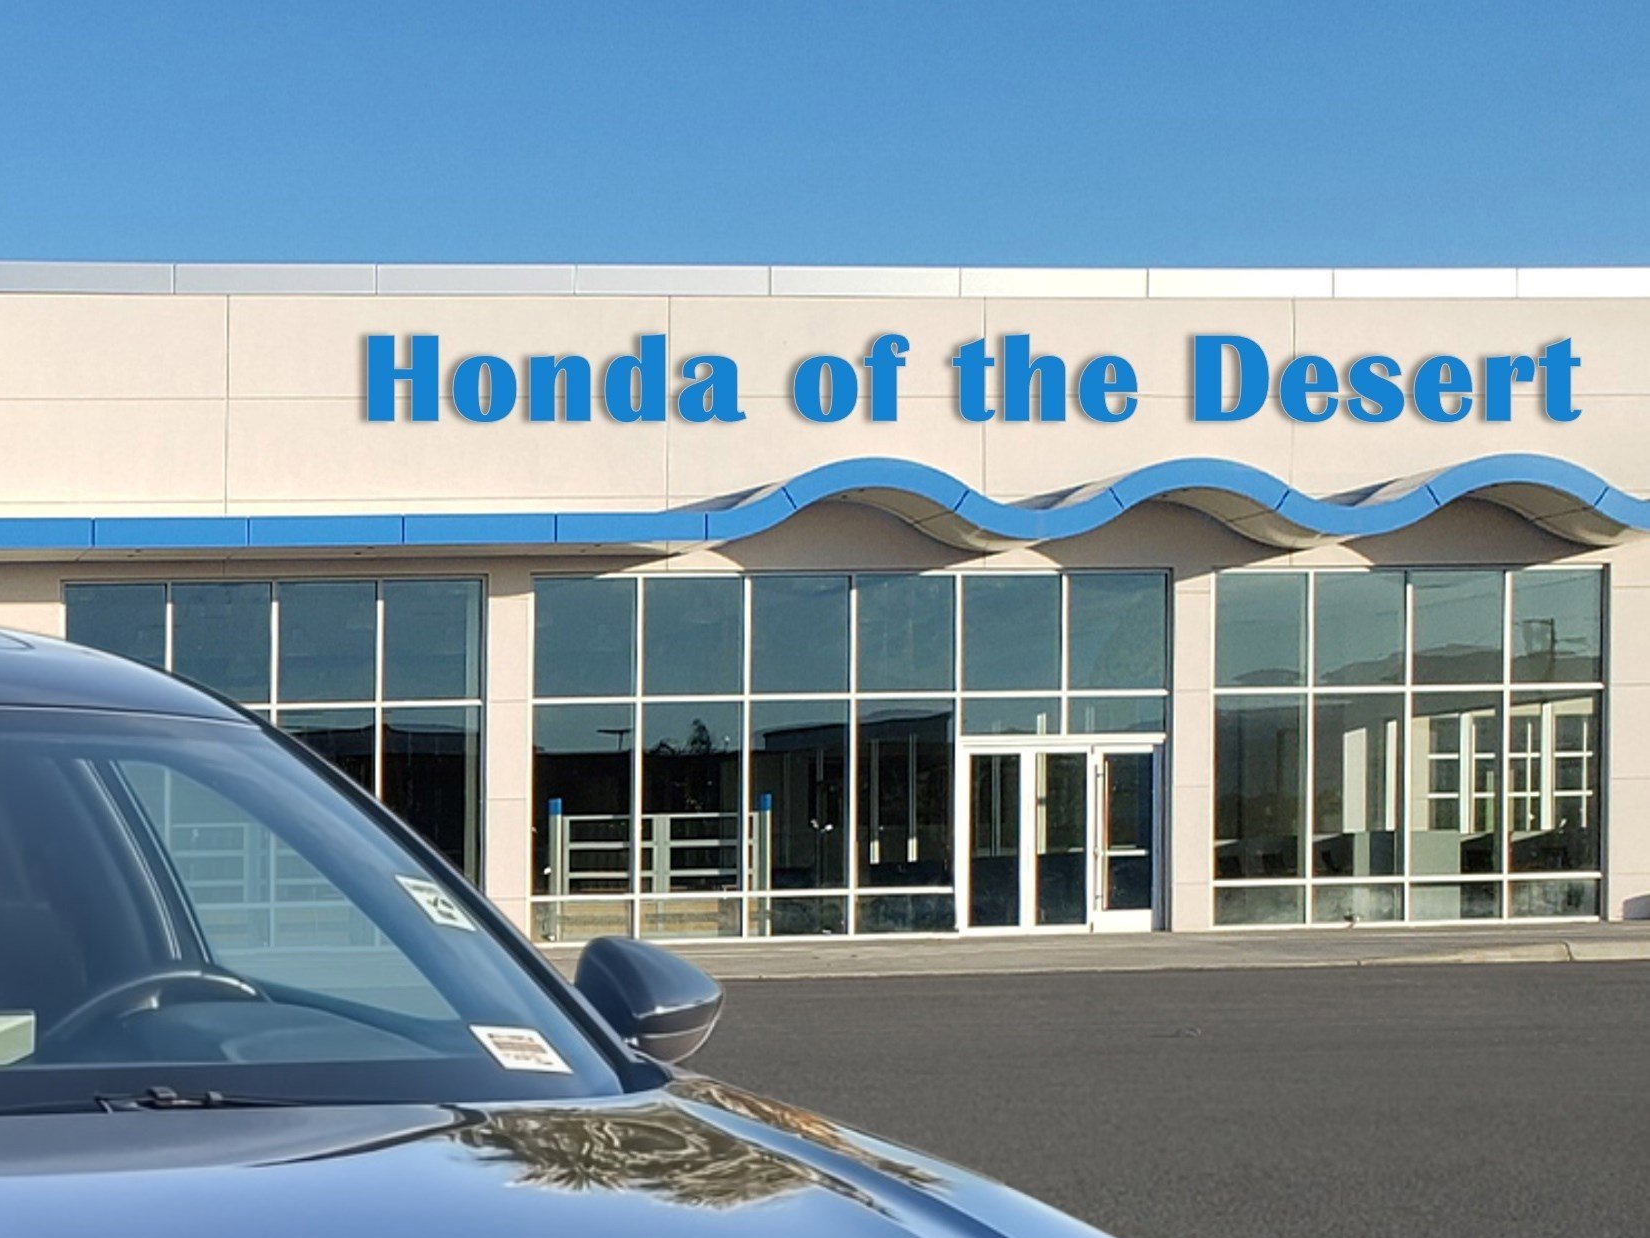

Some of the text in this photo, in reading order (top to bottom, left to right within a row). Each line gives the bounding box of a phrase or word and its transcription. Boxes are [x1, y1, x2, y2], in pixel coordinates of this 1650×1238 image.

[366, 332, 1582, 423] Honda of the Desert
